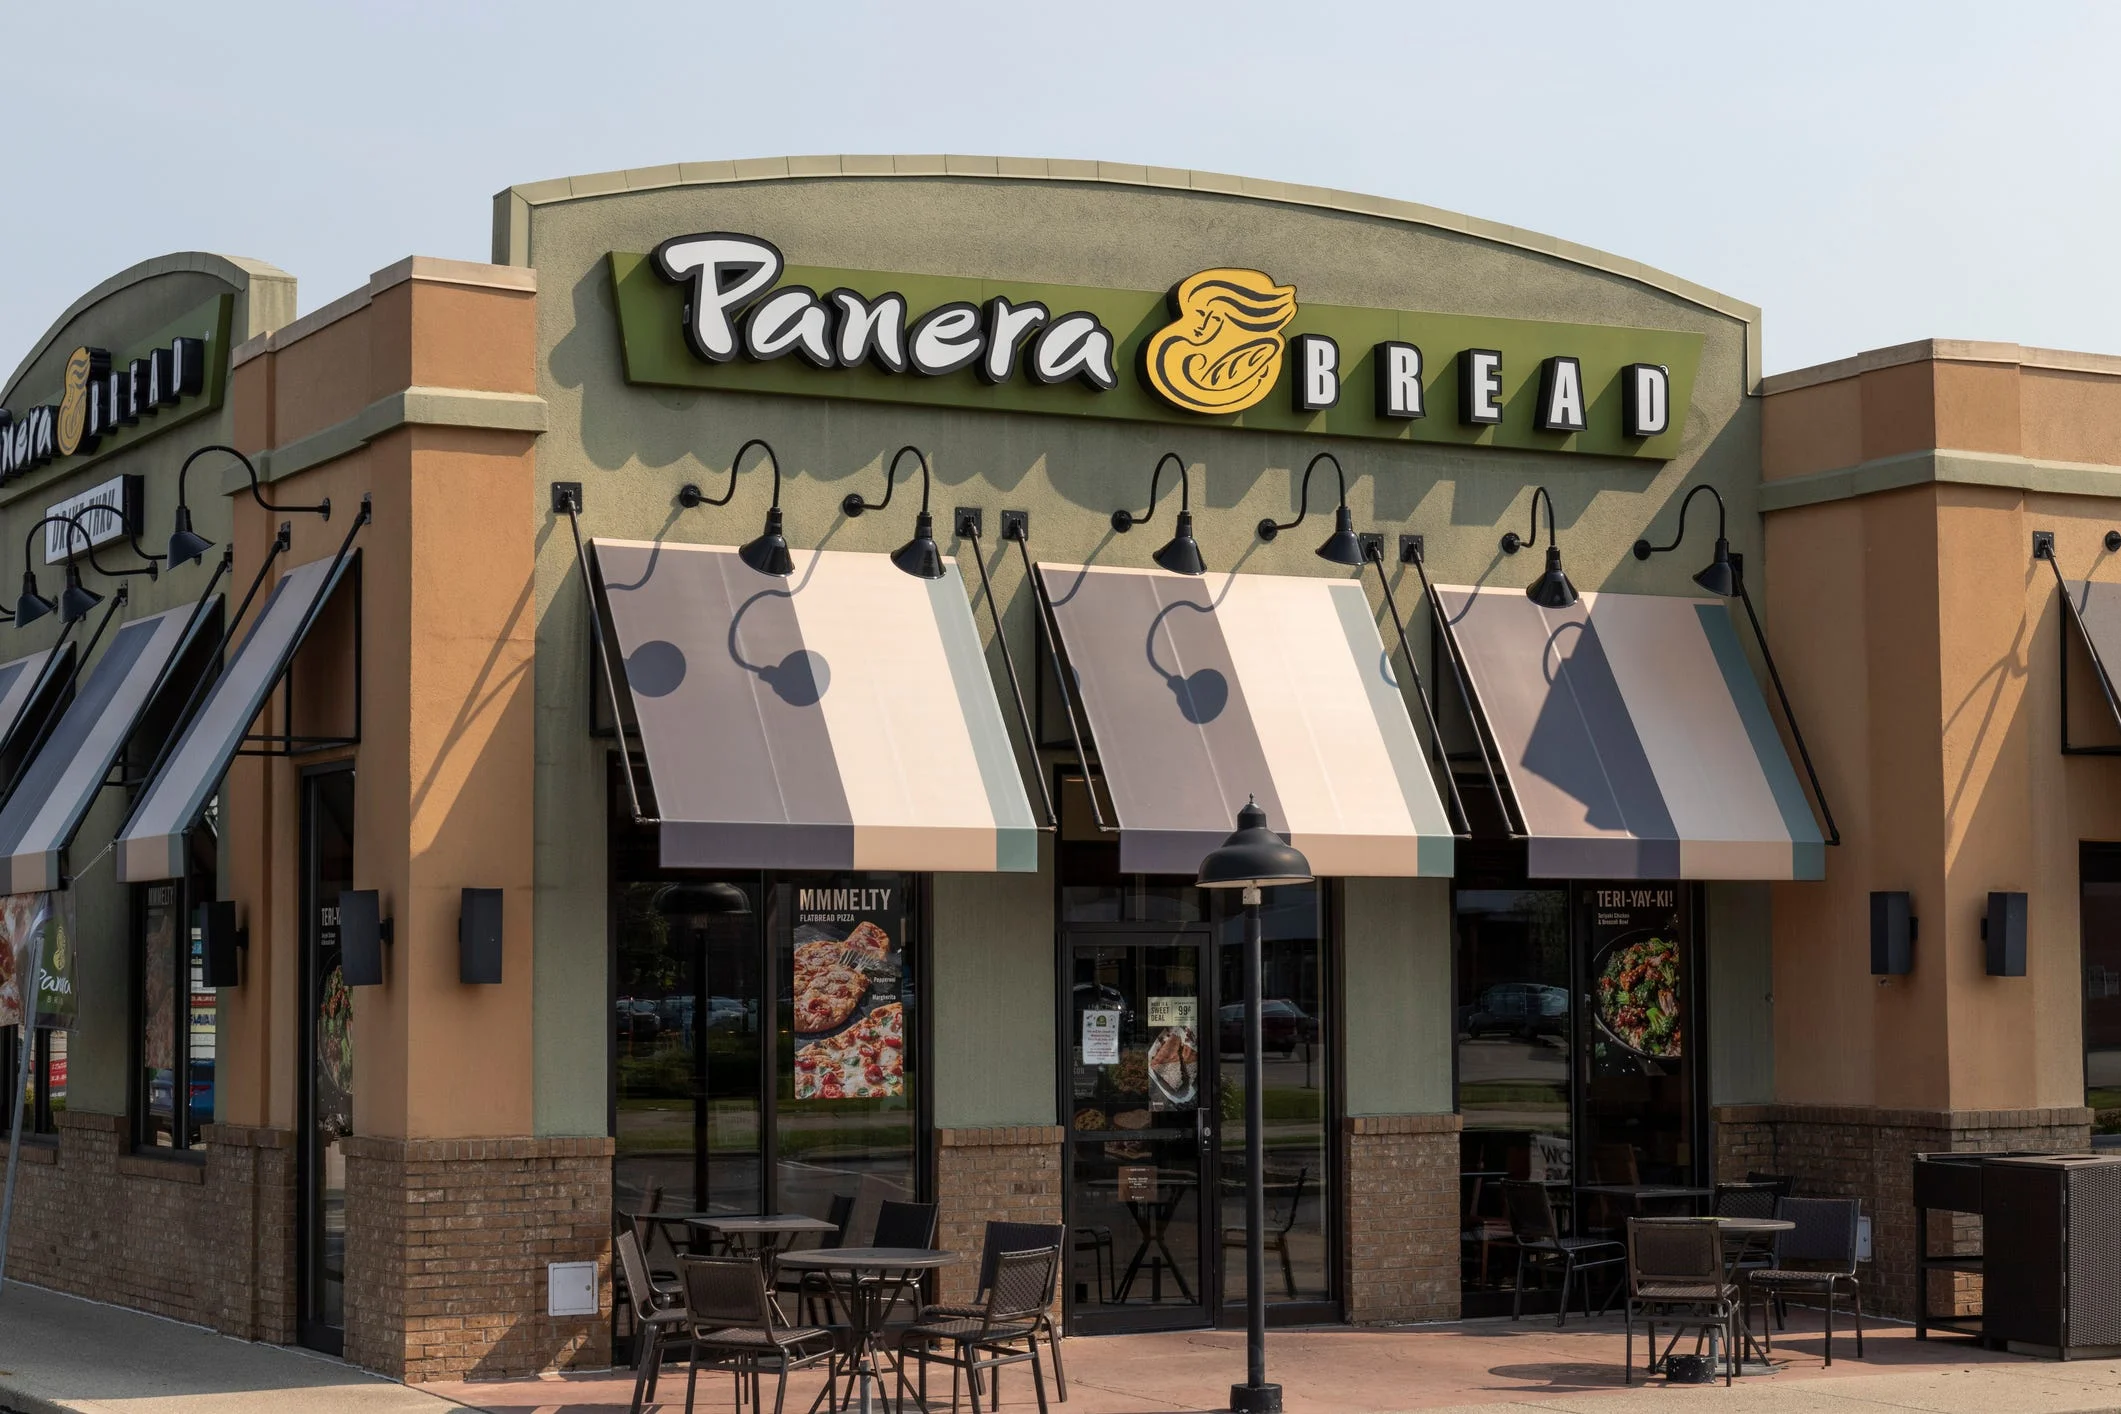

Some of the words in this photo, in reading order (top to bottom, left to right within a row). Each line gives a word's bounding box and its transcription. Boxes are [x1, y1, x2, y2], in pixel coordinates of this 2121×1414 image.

[654, 232, 1116, 390] Panera
[89, 336, 186, 437] BREAD
[1295, 333, 1670, 438] BREAD
[87, 487, 116, 538] THRU
[800, 889, 891, 910] MMMELTY
[1597, 890, 1673, 907] TERI-YAY-KI!
[799, 914, 835, 922] FLATBREAD
[836, 914, 855, 922] PIZZA
[1151, 1007, 1170, 1015] SWEET
[1151, 1015, 1166, 1023] DEAL
